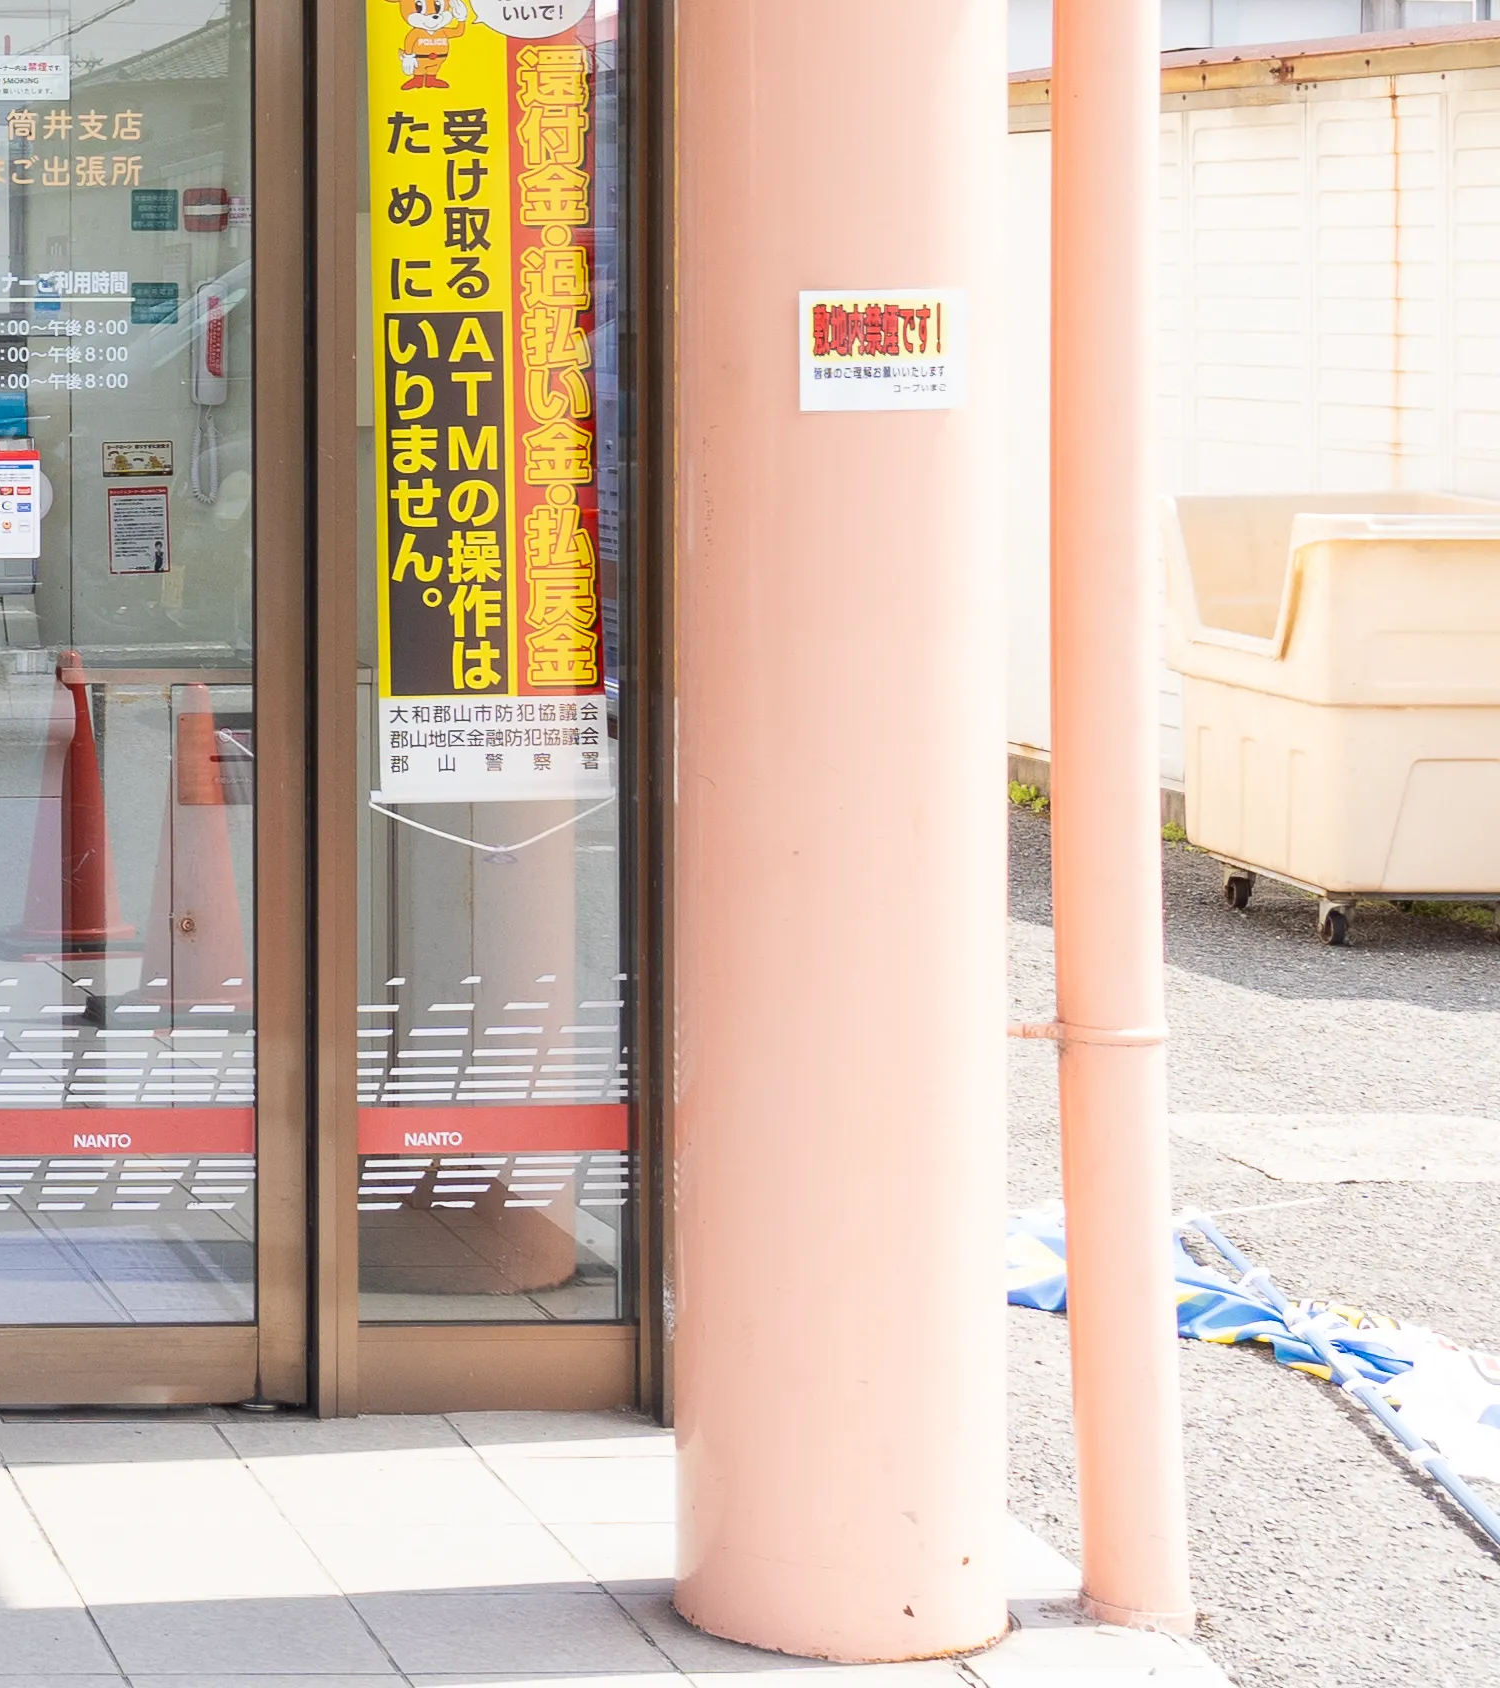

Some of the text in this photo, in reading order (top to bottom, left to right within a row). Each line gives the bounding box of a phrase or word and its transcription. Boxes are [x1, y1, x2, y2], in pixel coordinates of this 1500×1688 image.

[502, 5, 563, 21] いいで!
[417, 38, 448, 46] POLICE
[387, 110, 433, 301] ために
[442, 108, 492, 299] 受け取る
[516, 45, 598, 687] 還付金・過払い金・払戻金
[813, 366, 945, 380] 皆様のご理解お願いいたします
[893, 383, 947, 393] コープいまご
[387, 318, 443, 609] いりません。
[448, 317, 502, 690] ATMの操作は
[389, 702, 599, 724] 大和郡山市防犯協議会
[390, 726, 599, 749] 郡山地区金融防犯協議会
[390, 752, 599, 773] 郡山警察署
[73, 1134, 131, 1148] NANTO
[404, 1132, 462, 1146] NANTO
